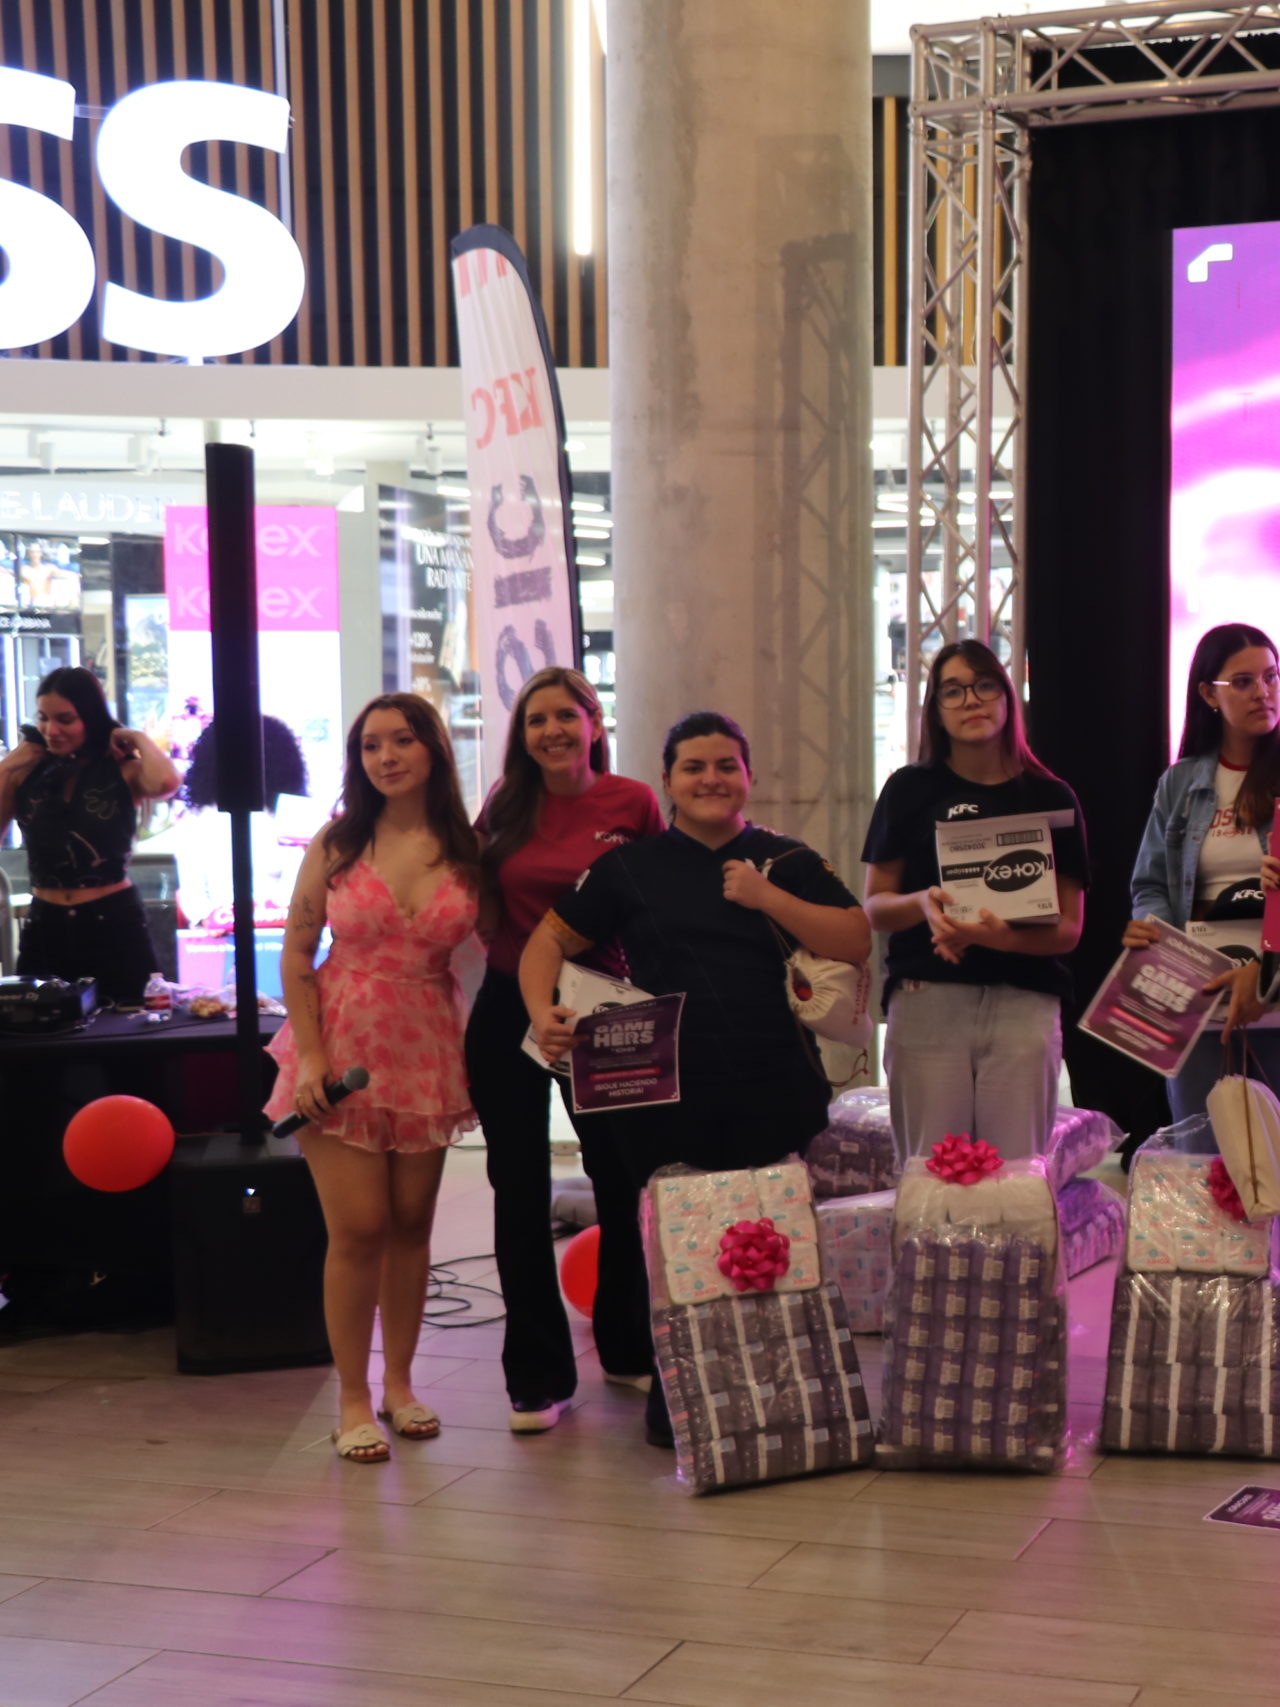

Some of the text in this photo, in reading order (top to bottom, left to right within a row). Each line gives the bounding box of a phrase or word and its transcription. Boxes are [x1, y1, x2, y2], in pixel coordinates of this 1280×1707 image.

[174, 521, 324, 557] kex
[175, 583, 325, 619] kex
[947, 803, 979, 819] KFC
[986, 860, 1046, 881] kotex
[1231, 888, 1265, 902] KFC
[595, 1020, 656, 1034] GAME
[593, 1031, 655, 1048] HERS
